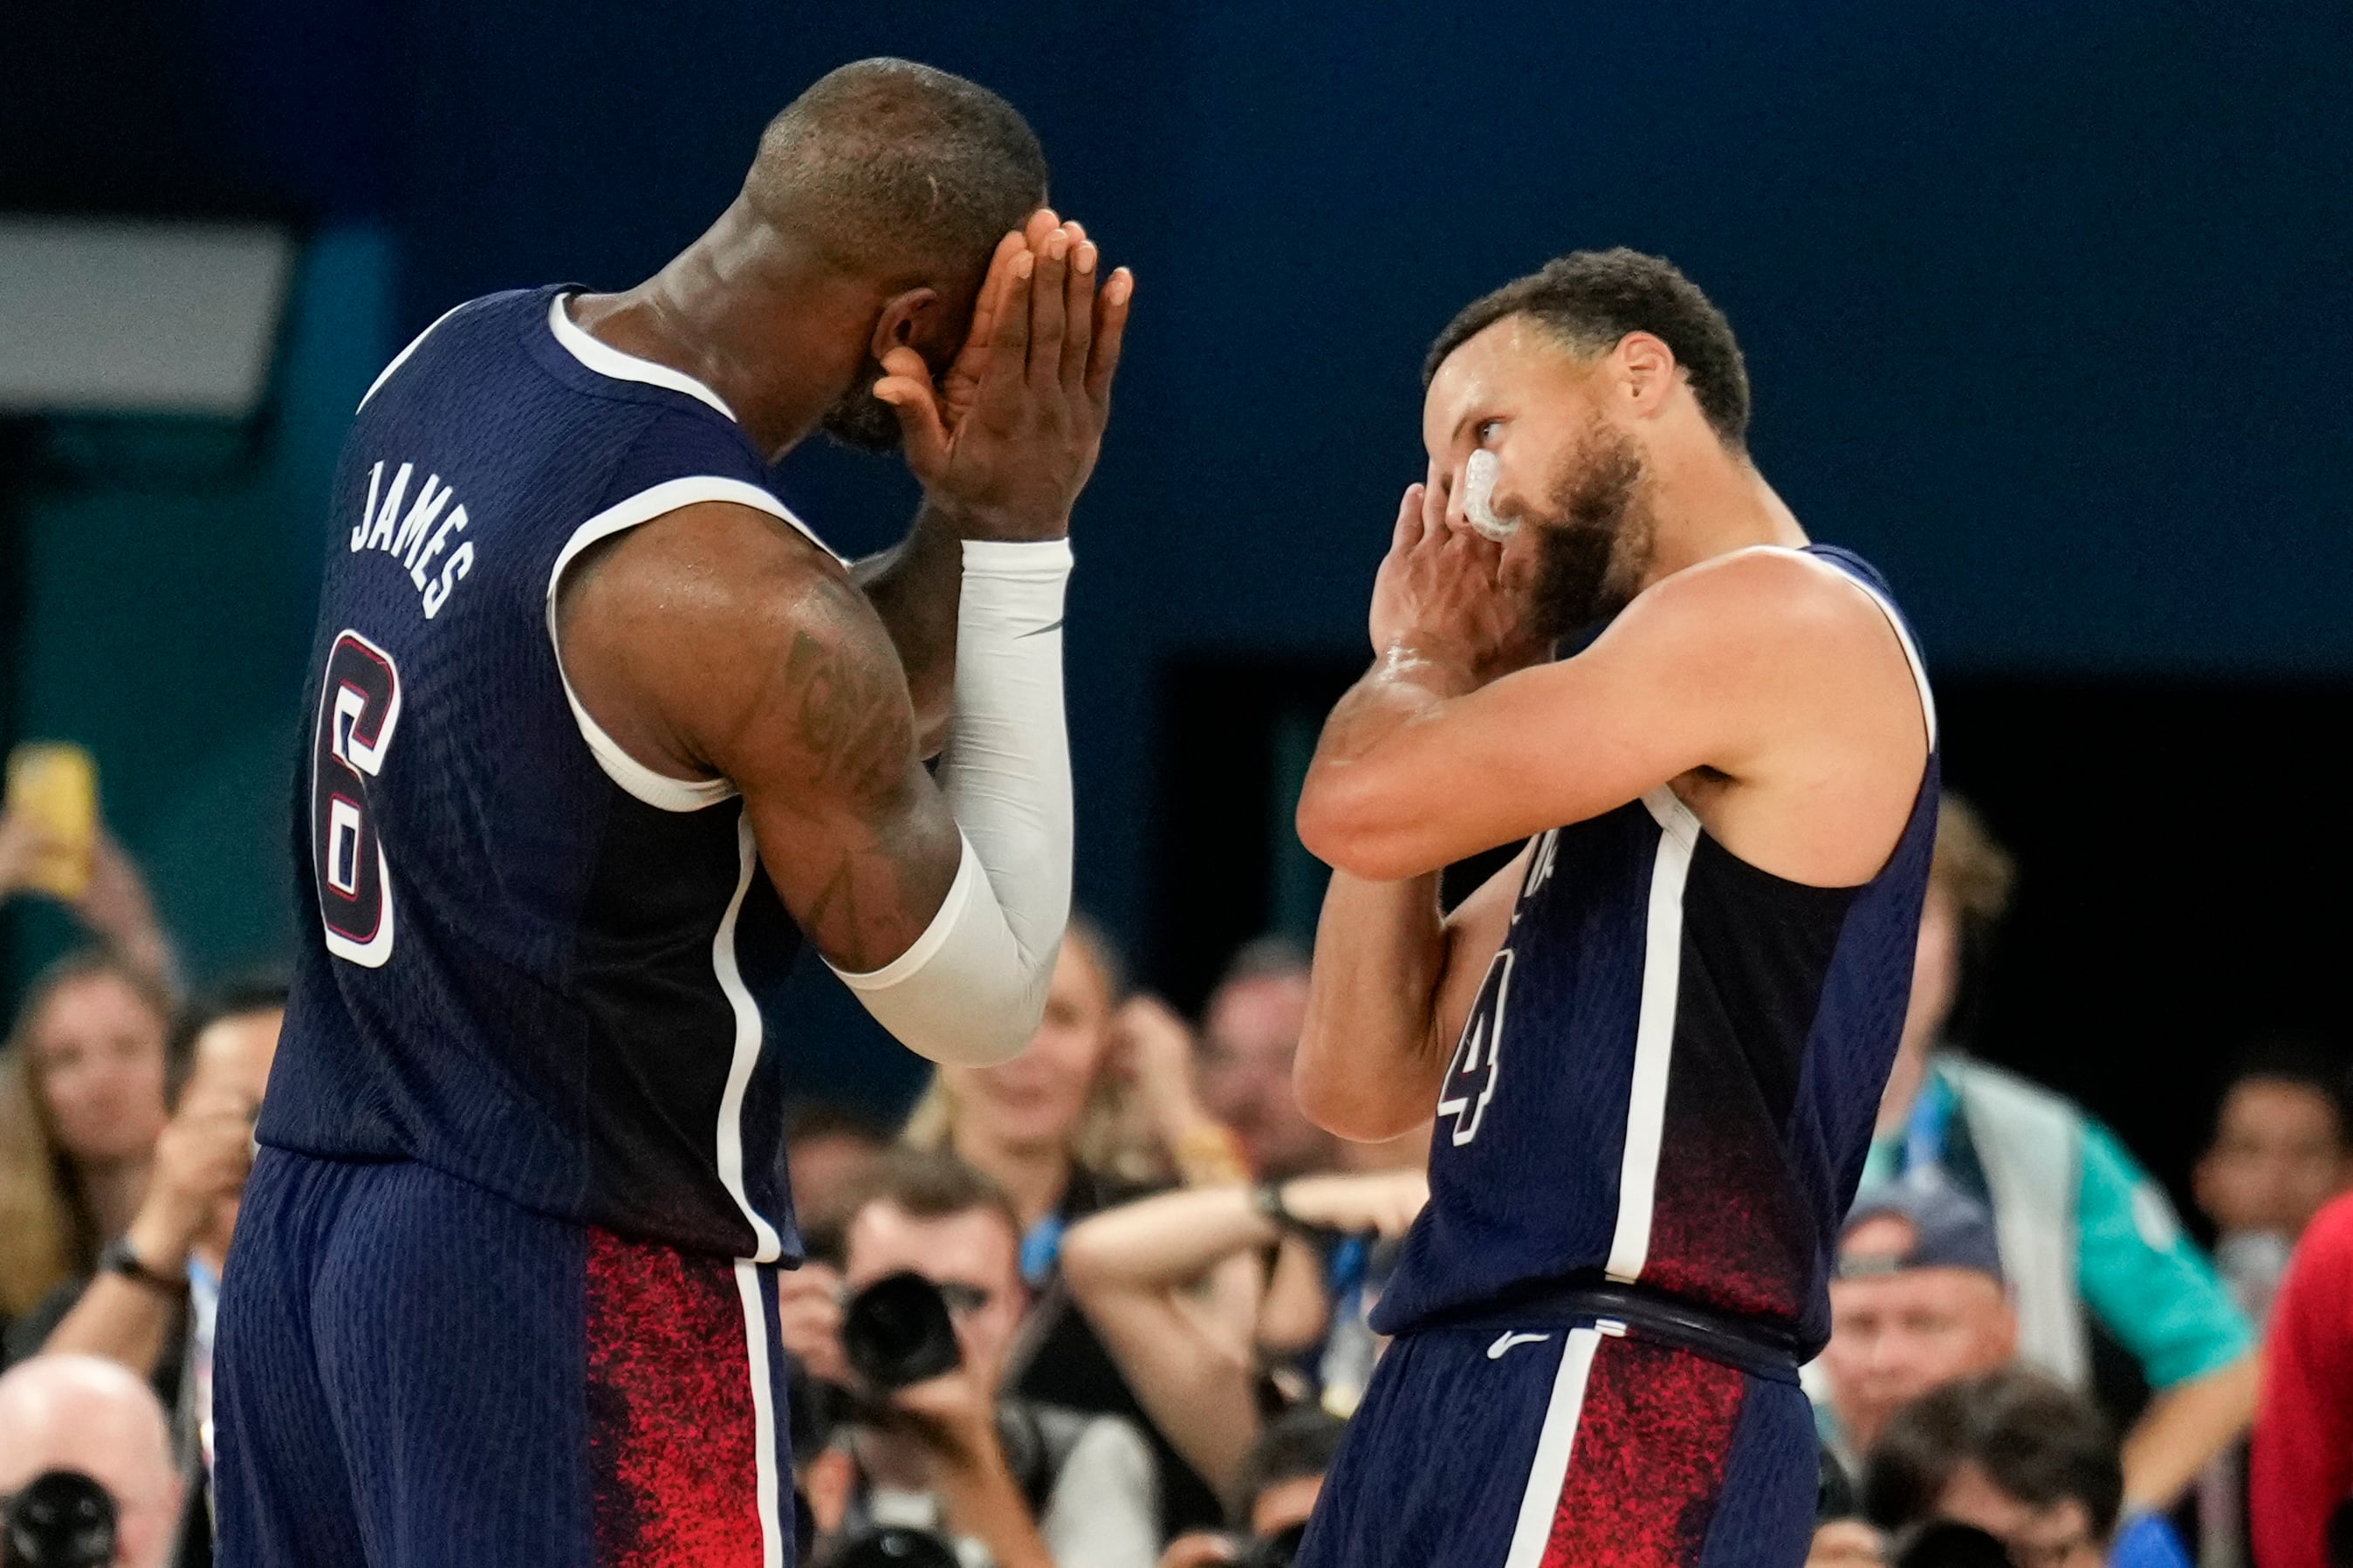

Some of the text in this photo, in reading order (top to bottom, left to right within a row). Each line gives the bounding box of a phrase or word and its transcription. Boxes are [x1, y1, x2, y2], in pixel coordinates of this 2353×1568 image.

[351, 461, 474, 620] JAMES
[312, 628, 401, 968] 6
[1437, 948, 1515, 1147] 4
